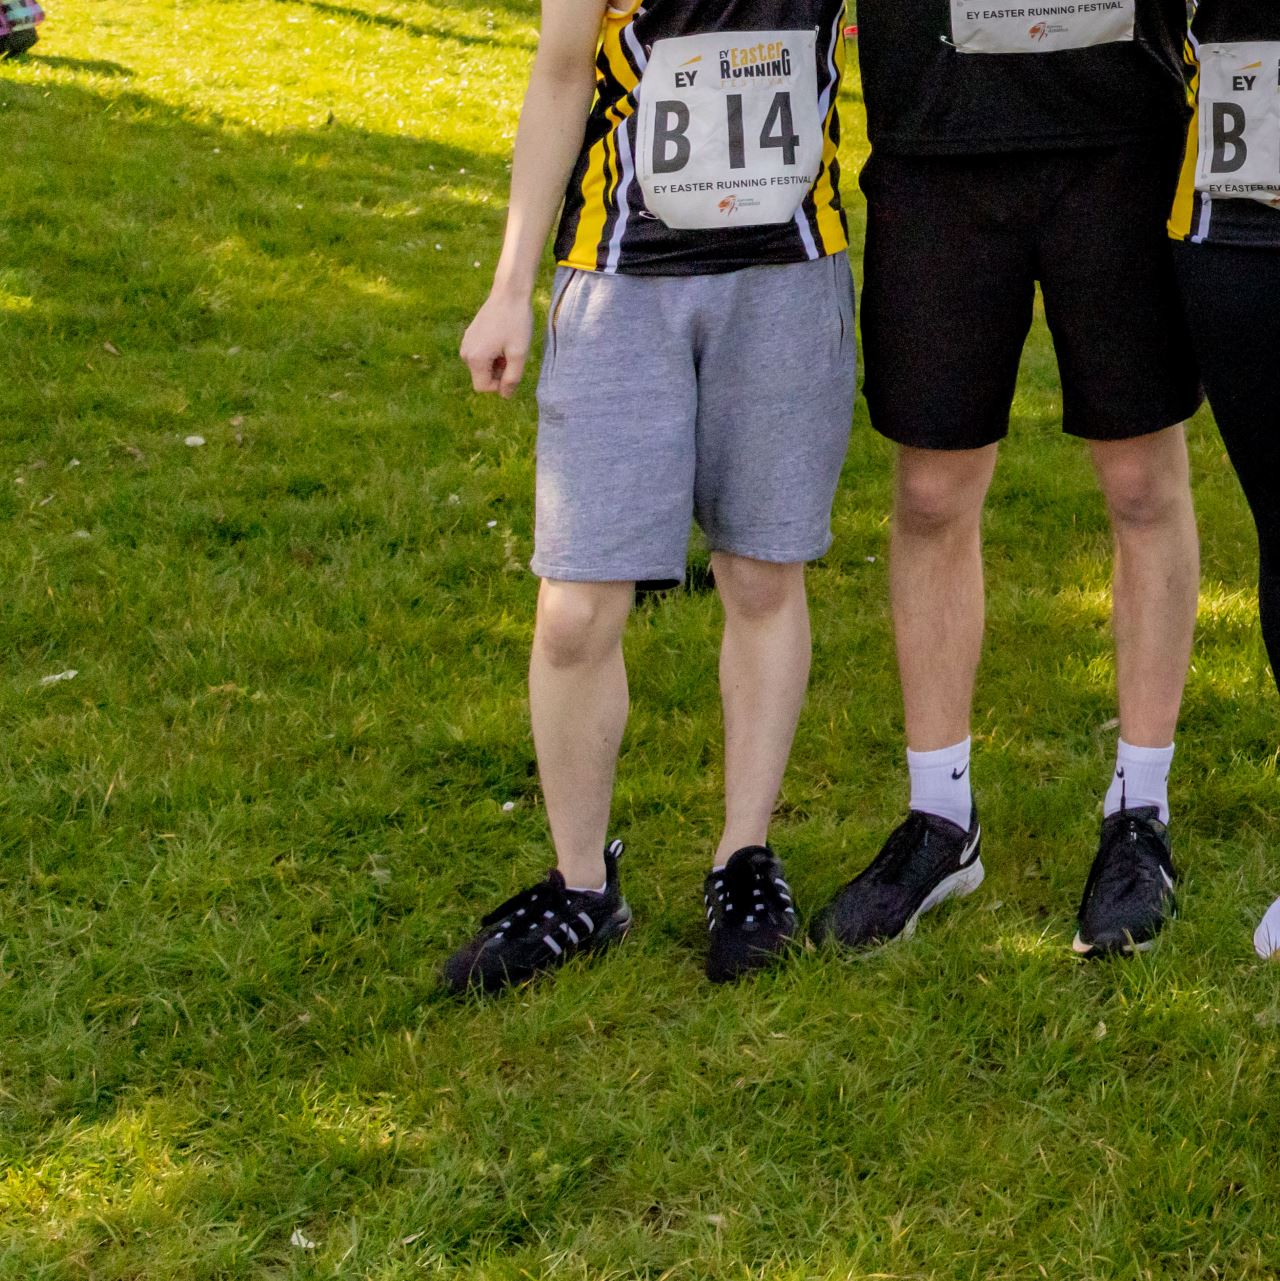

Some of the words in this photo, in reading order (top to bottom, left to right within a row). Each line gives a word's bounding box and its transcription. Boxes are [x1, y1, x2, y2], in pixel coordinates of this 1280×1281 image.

[967, 10, 980, 20] EY
[984, 8, 1025, 19] EASTER
[1028, 6, 1075, 17] RUNNING
[1078, 1, 1123, 13] FESTIVAL
[720, 50, 729, 60] EY
[730, 40, 783, 64] Easter
[720, 48, 791, 79] RUNNING
[675, 70, 698, 88] EY
[1232, 76, 1257, 91] EY
[652, 100, 690, 174] B
[726, 91, 800, 169] 14
[1210, 101, 1248, 174] B
[653, 185, 669, 194] EY
[670, 182, 713, 193] EASTER
[716, 177, 767, 190] RUNNING
[770, 175, 812, 185] FESTIVAL
[1225, 184, 1265, 192] EASTER
